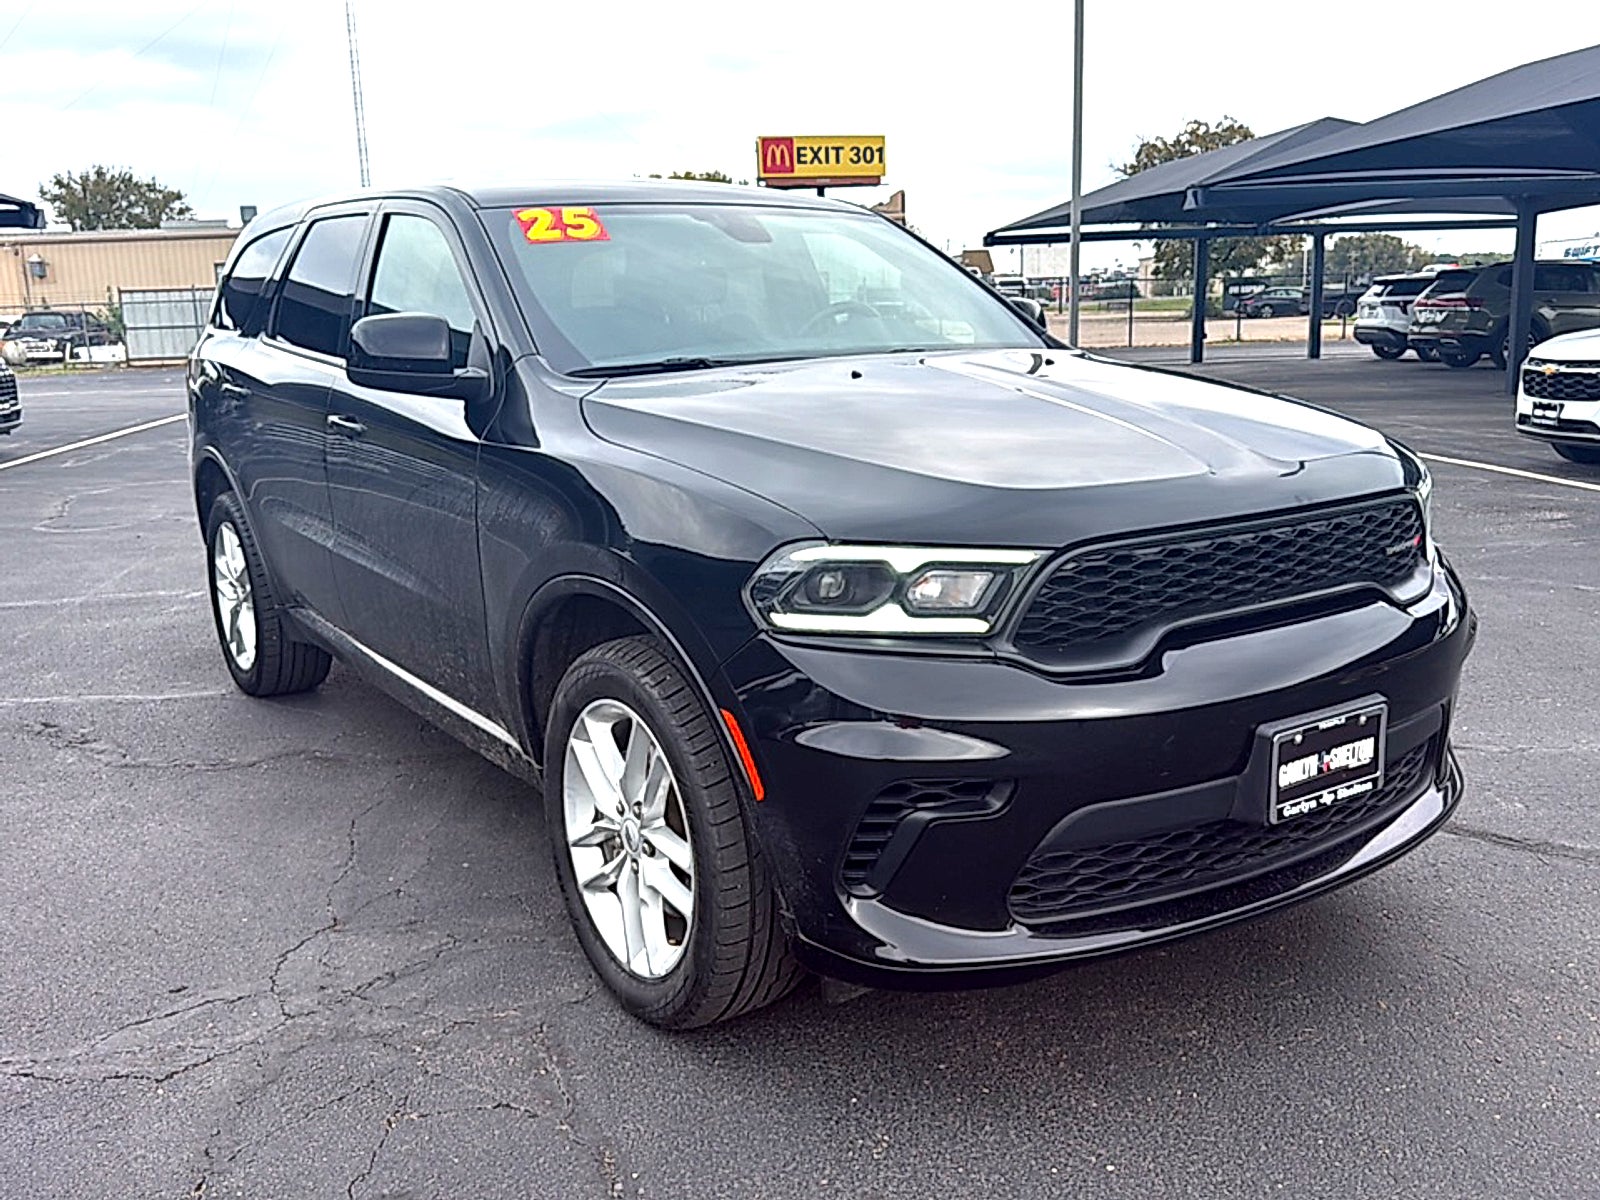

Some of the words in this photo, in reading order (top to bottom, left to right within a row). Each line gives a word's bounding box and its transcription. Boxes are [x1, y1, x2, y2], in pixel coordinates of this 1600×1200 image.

[796, 146, 844, 165] EXIT
[849, 146, 884, 165] 301
[517, 207, 602, 241] 25
